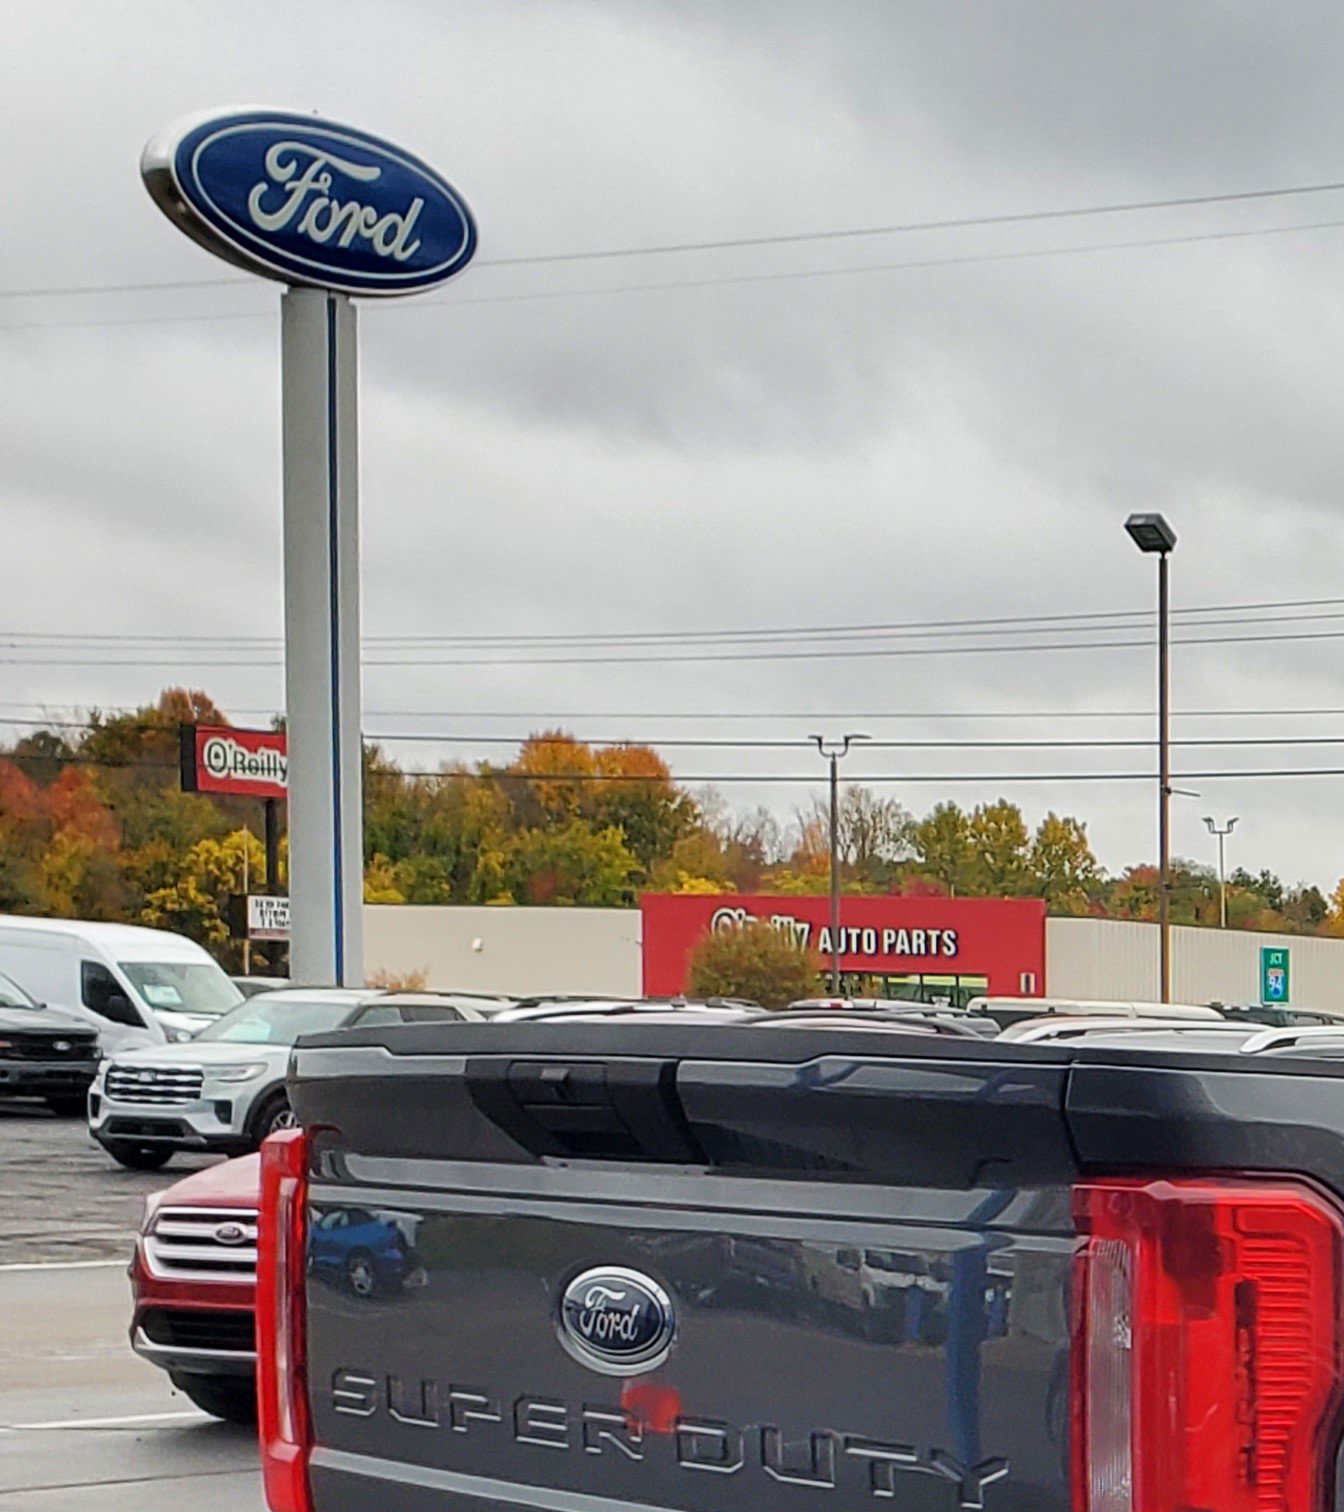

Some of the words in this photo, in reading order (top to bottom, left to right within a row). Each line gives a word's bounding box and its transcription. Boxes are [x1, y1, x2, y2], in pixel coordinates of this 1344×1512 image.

[248, 141, 424, 261] Ford
[206, 739, 289, 783] O'Reilly
[882, 928, 958, 957] PARTS
[579, 1285, 642, 1342] Ford
[331, 1367, 644, 1460] SUPER
[675, 1414, 1010, 1509] DUTY
